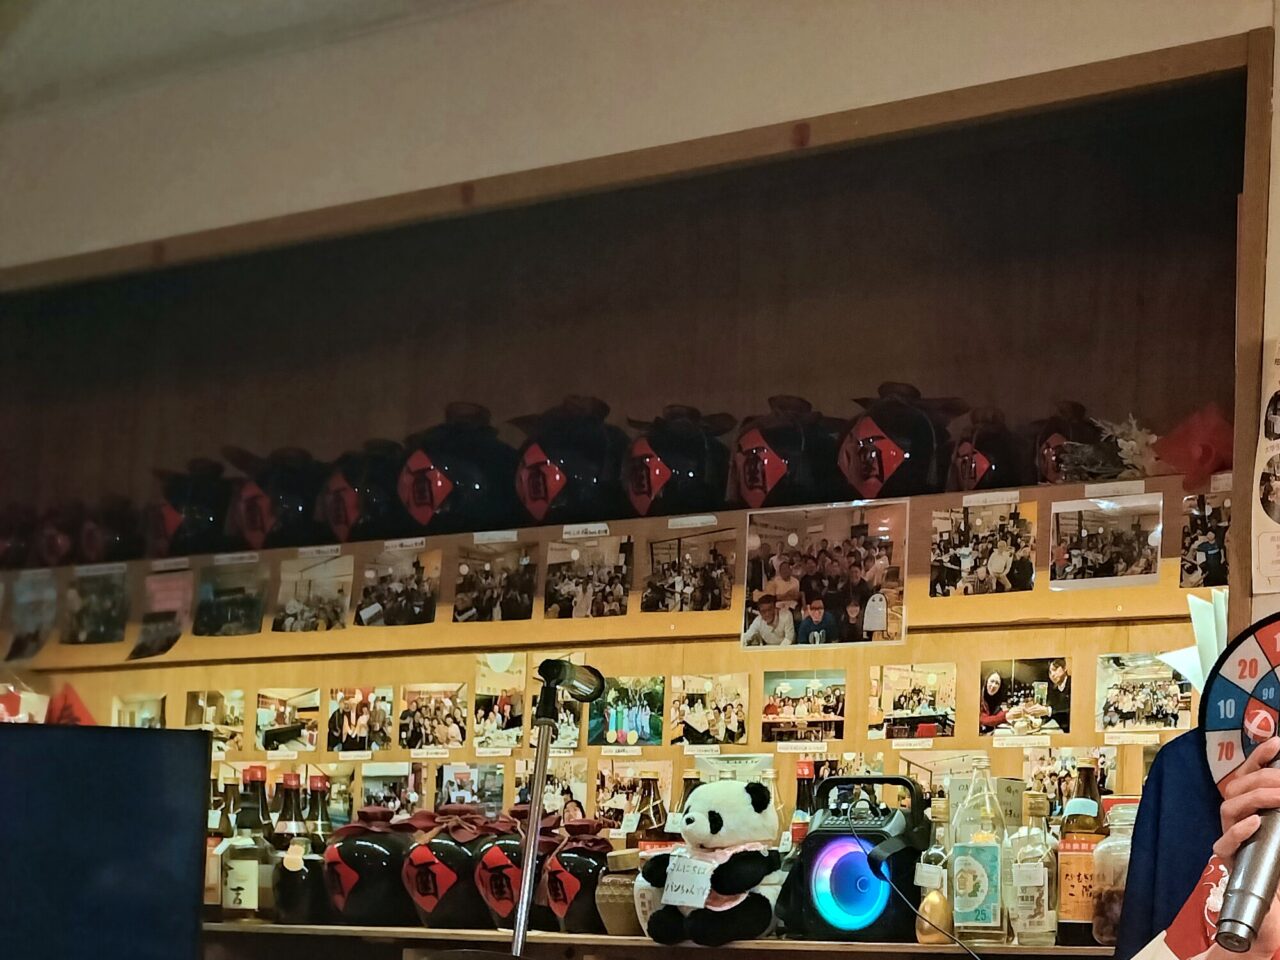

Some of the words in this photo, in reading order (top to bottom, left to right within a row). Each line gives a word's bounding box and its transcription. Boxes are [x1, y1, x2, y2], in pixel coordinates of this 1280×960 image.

[1237, 658, 1258, 680] 20
[1217, 698, 1236, 719] 10
[1217, 740, 1235, 762] 70
[974, 908, 987, 922] 25
